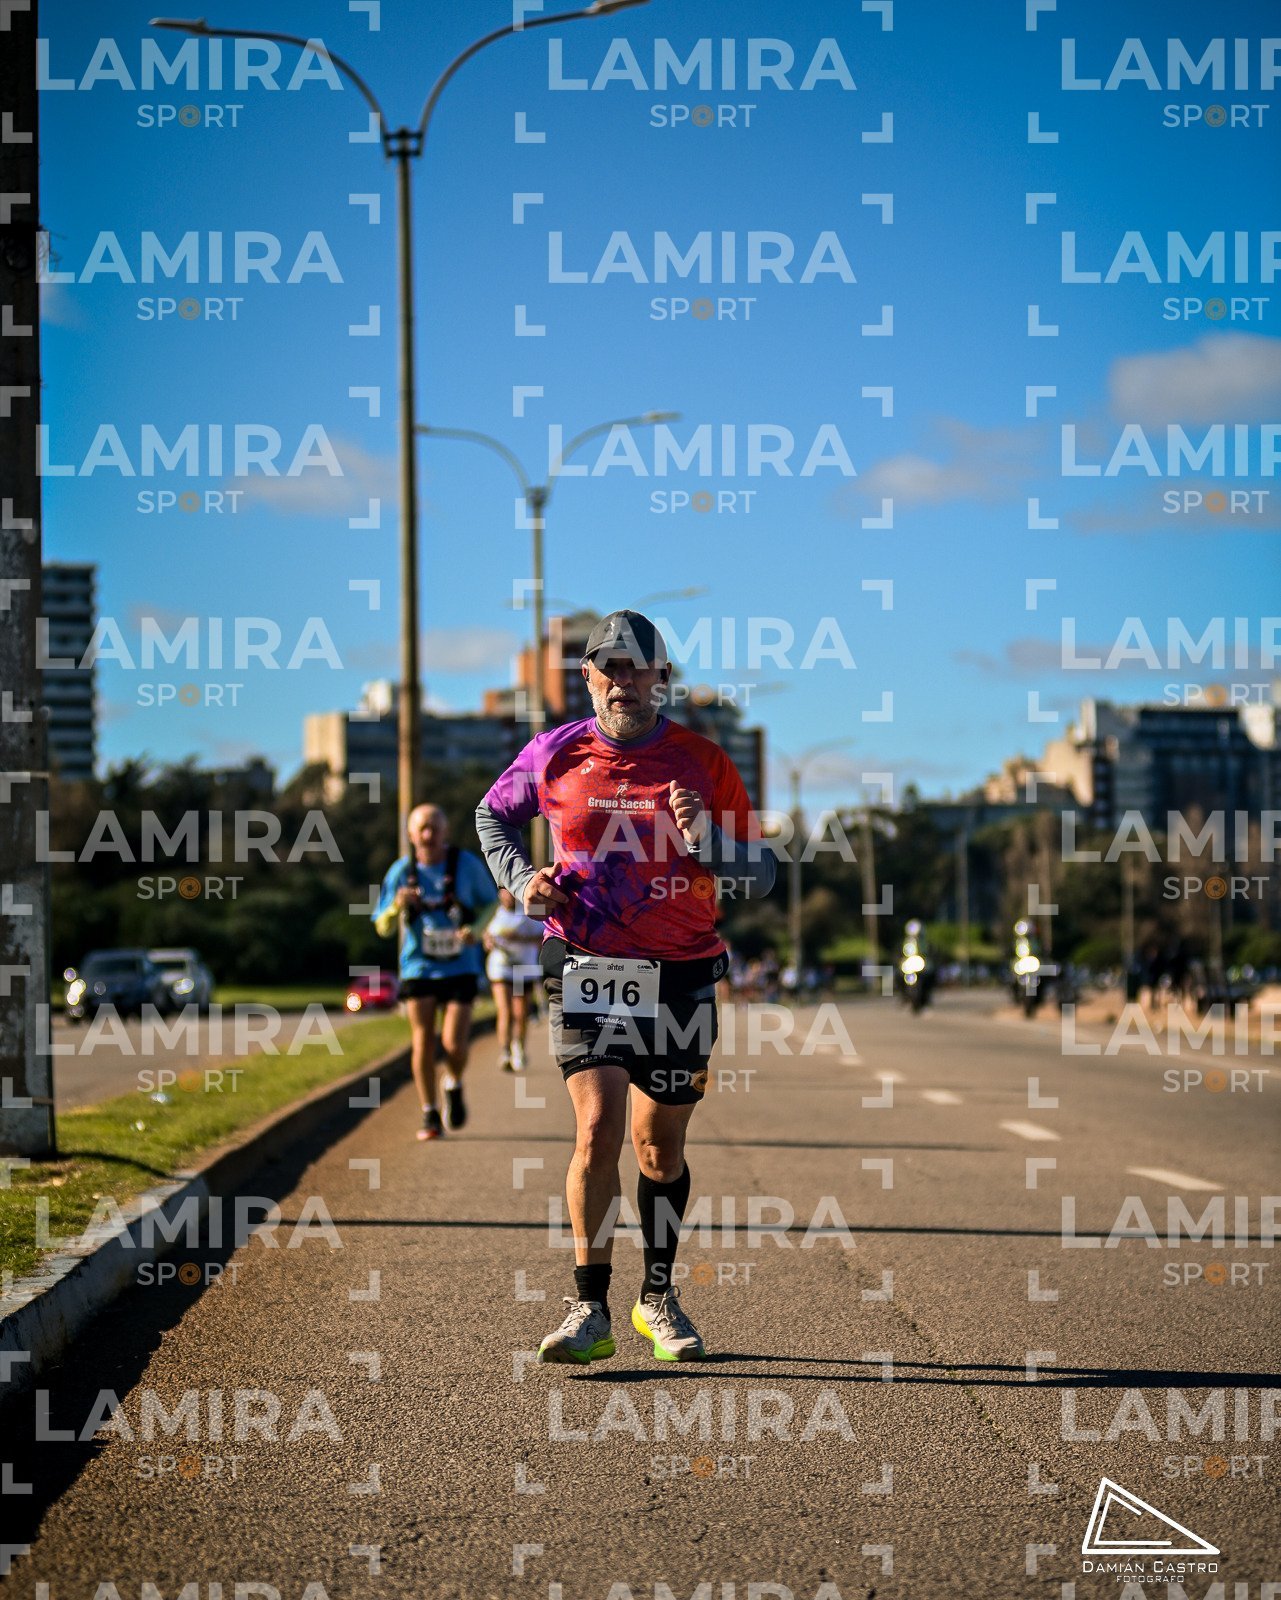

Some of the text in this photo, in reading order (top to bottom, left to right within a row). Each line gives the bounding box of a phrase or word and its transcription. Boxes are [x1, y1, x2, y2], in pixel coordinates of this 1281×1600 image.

[588, 797, 655, 810] Grupo Sacchi
[607, 963, 624, 972] antel
[580, 978, 640, 1007] 916
